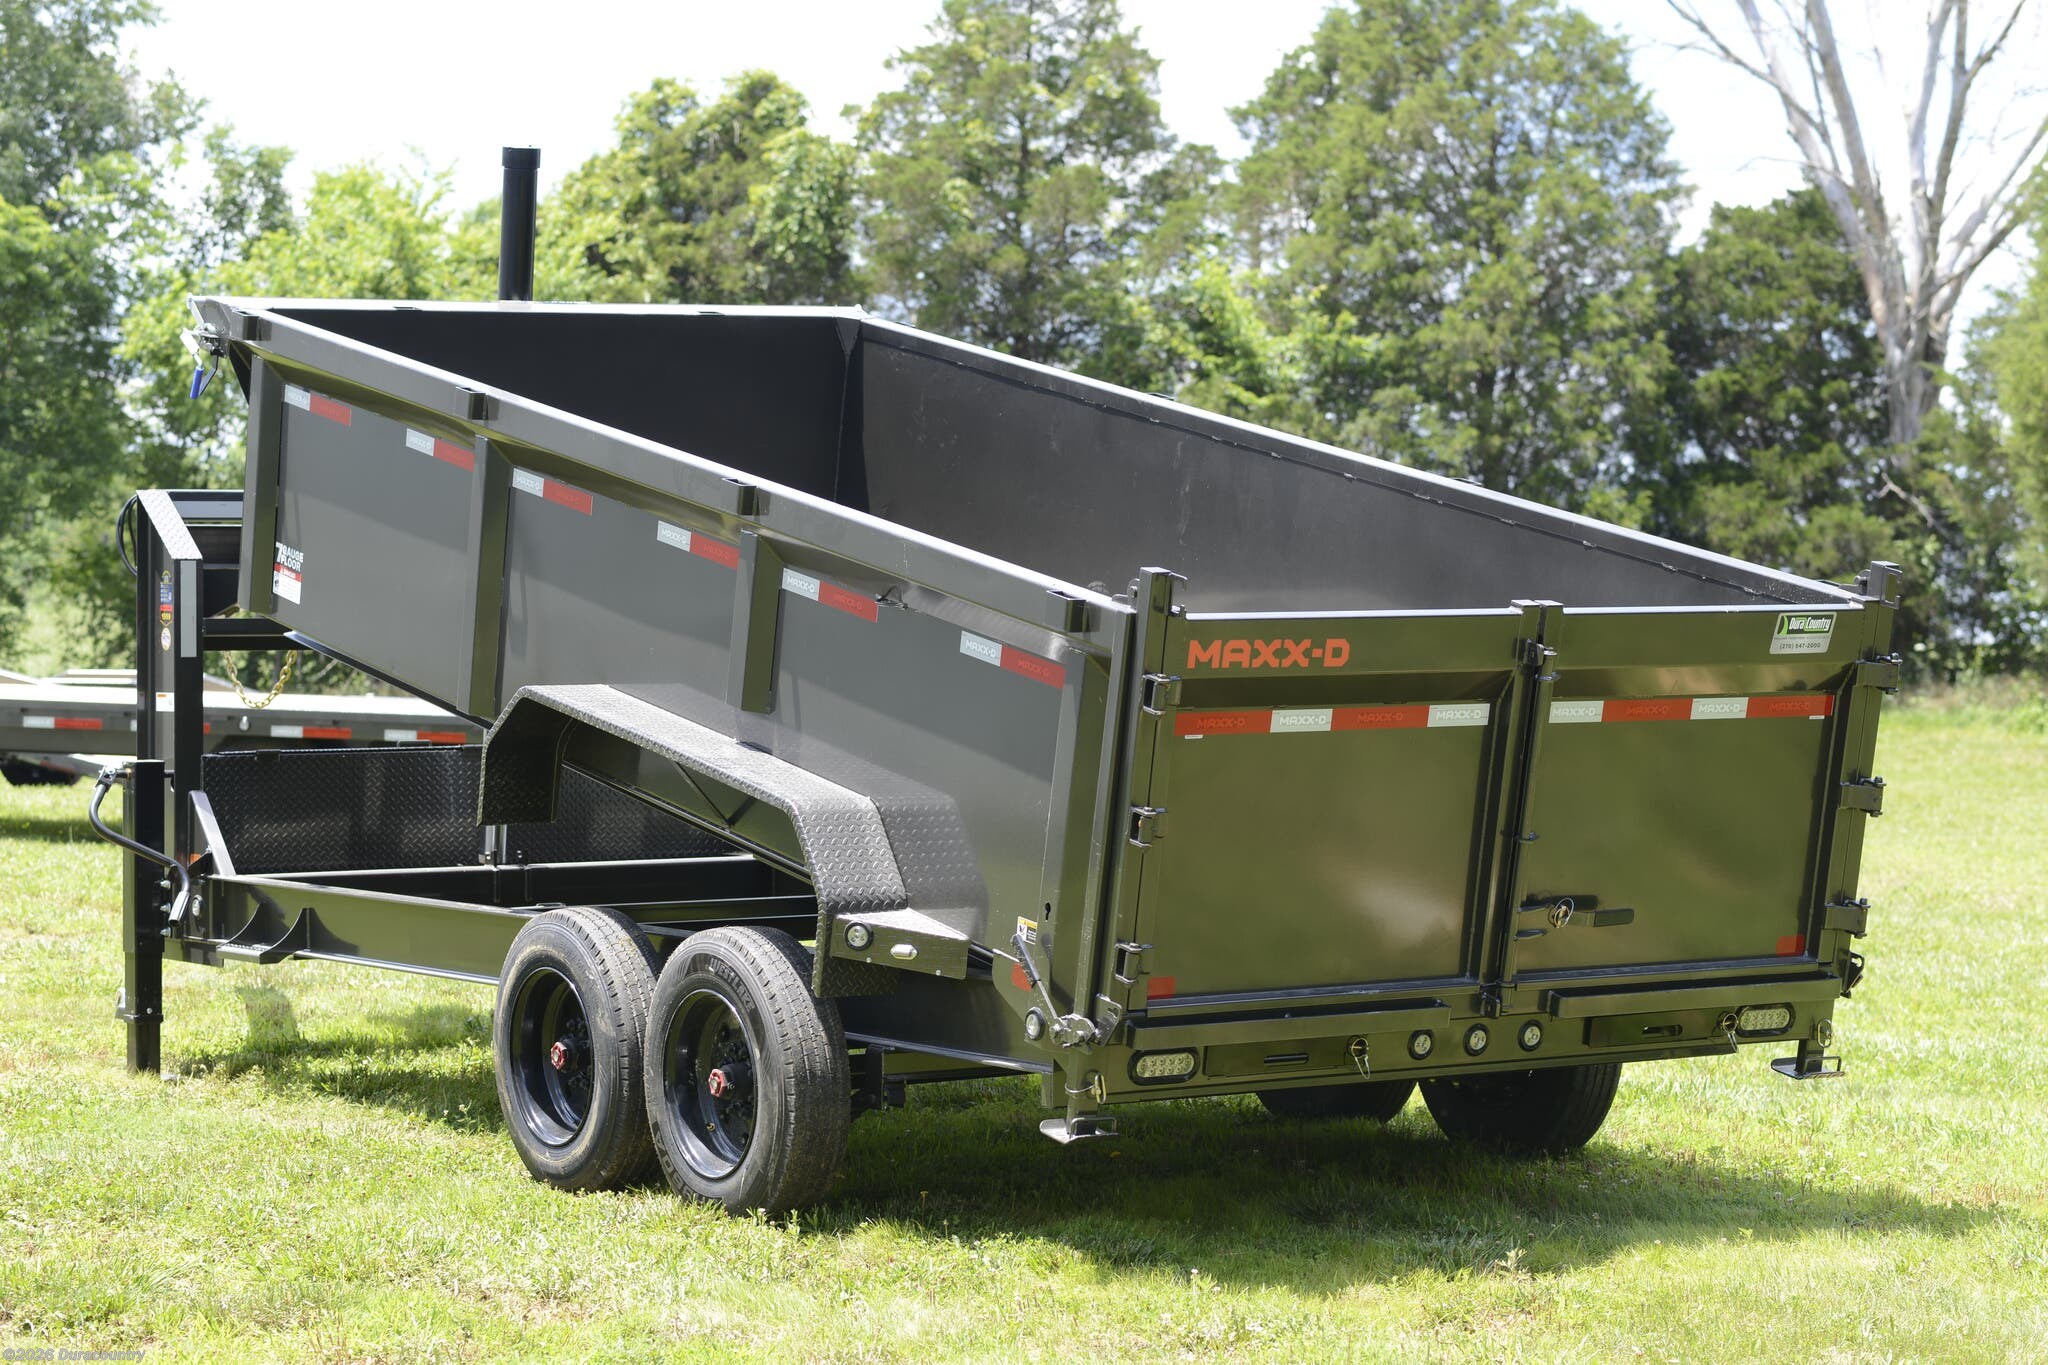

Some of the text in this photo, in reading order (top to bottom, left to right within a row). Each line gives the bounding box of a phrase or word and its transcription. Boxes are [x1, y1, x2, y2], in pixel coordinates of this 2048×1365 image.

[276, 541, 304, 563] 7 GAUGE
[280, 554, 301, 573] FLOOR
[786, 575, 815, 593] MAXX-D
[965, 639, 997, 659] MAXX-D
[1187, 638, 1350, 669] MAXX-D
[1435, 709, 1482, 721] MAXX-D
[1552, 707, 1597, 718] MAXX-D
[1698, 703, 1741, 713] MAXX-D
[1197, 717, 1246, 729] MAXX-D
[1279, 715, 1327, 726] MAXX-D
